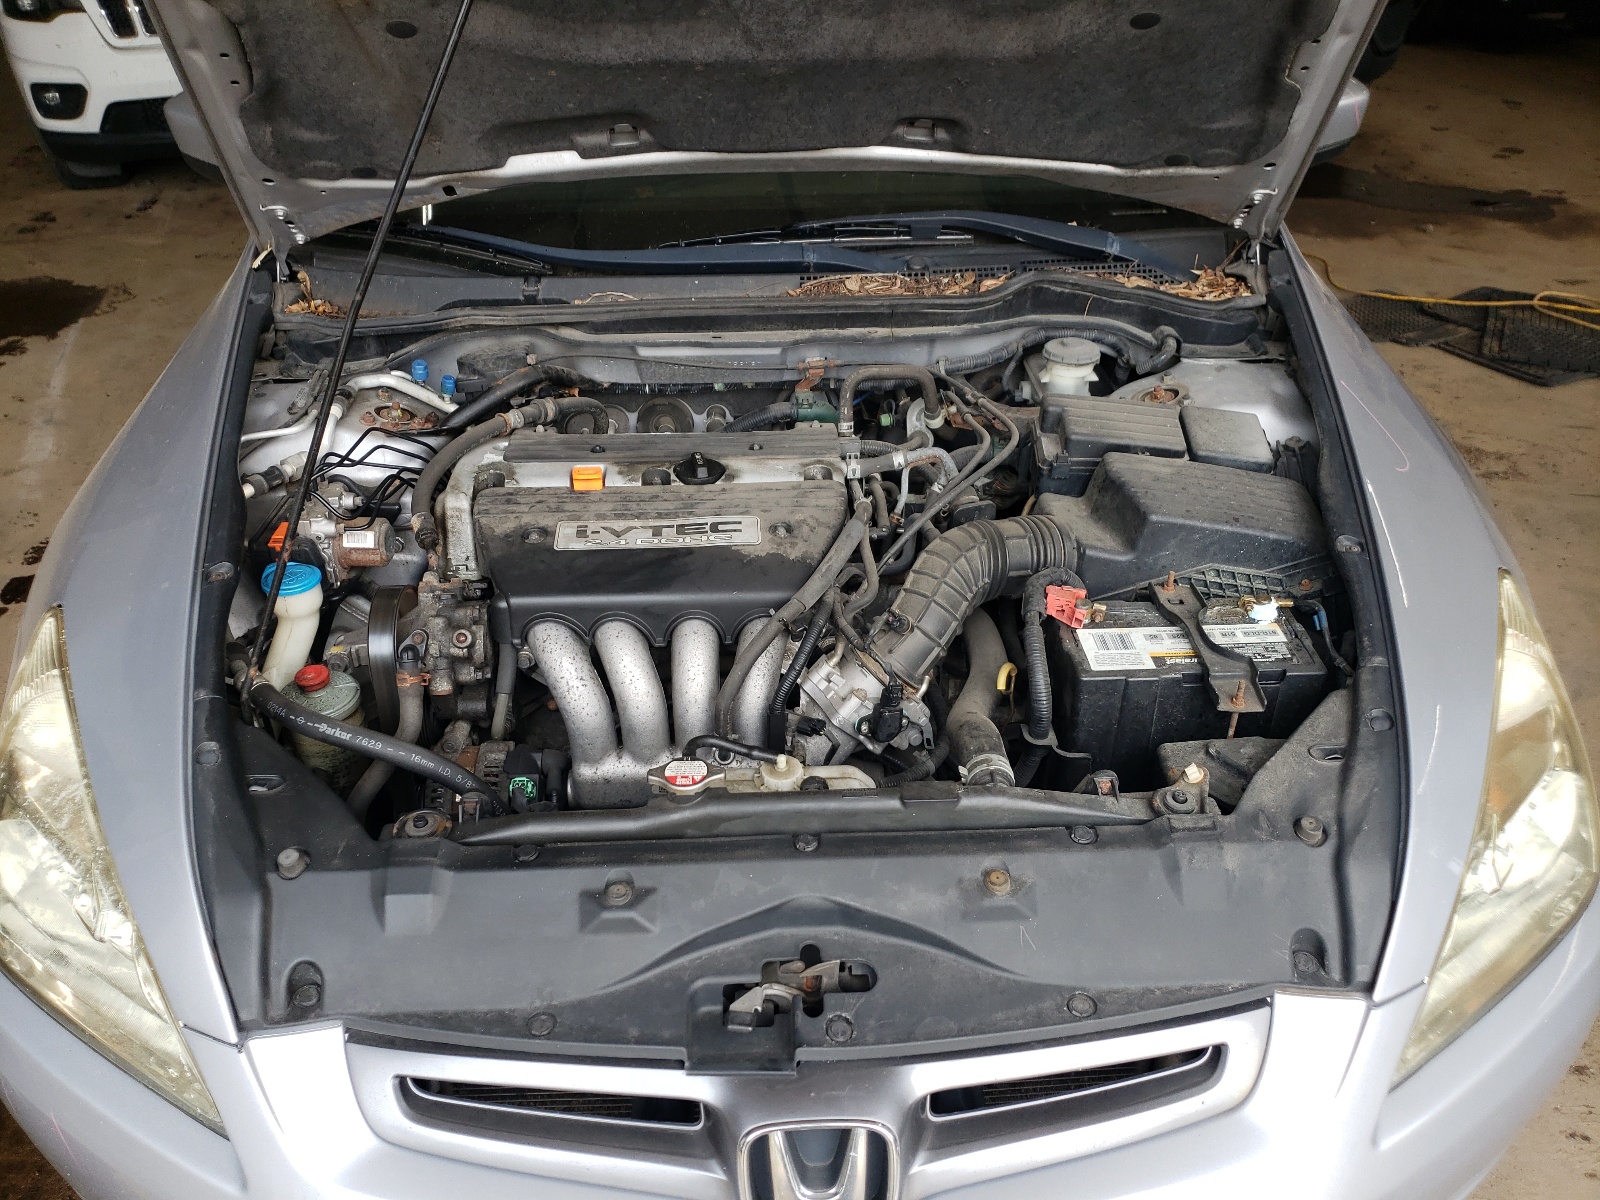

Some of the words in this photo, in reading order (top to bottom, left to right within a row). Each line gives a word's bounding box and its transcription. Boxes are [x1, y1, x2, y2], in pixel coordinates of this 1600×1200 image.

[575, 521, 743, 539] i-VTEC
[356, 735, 382, 750] 7629
[410, 753, 435, 769] 16mm
